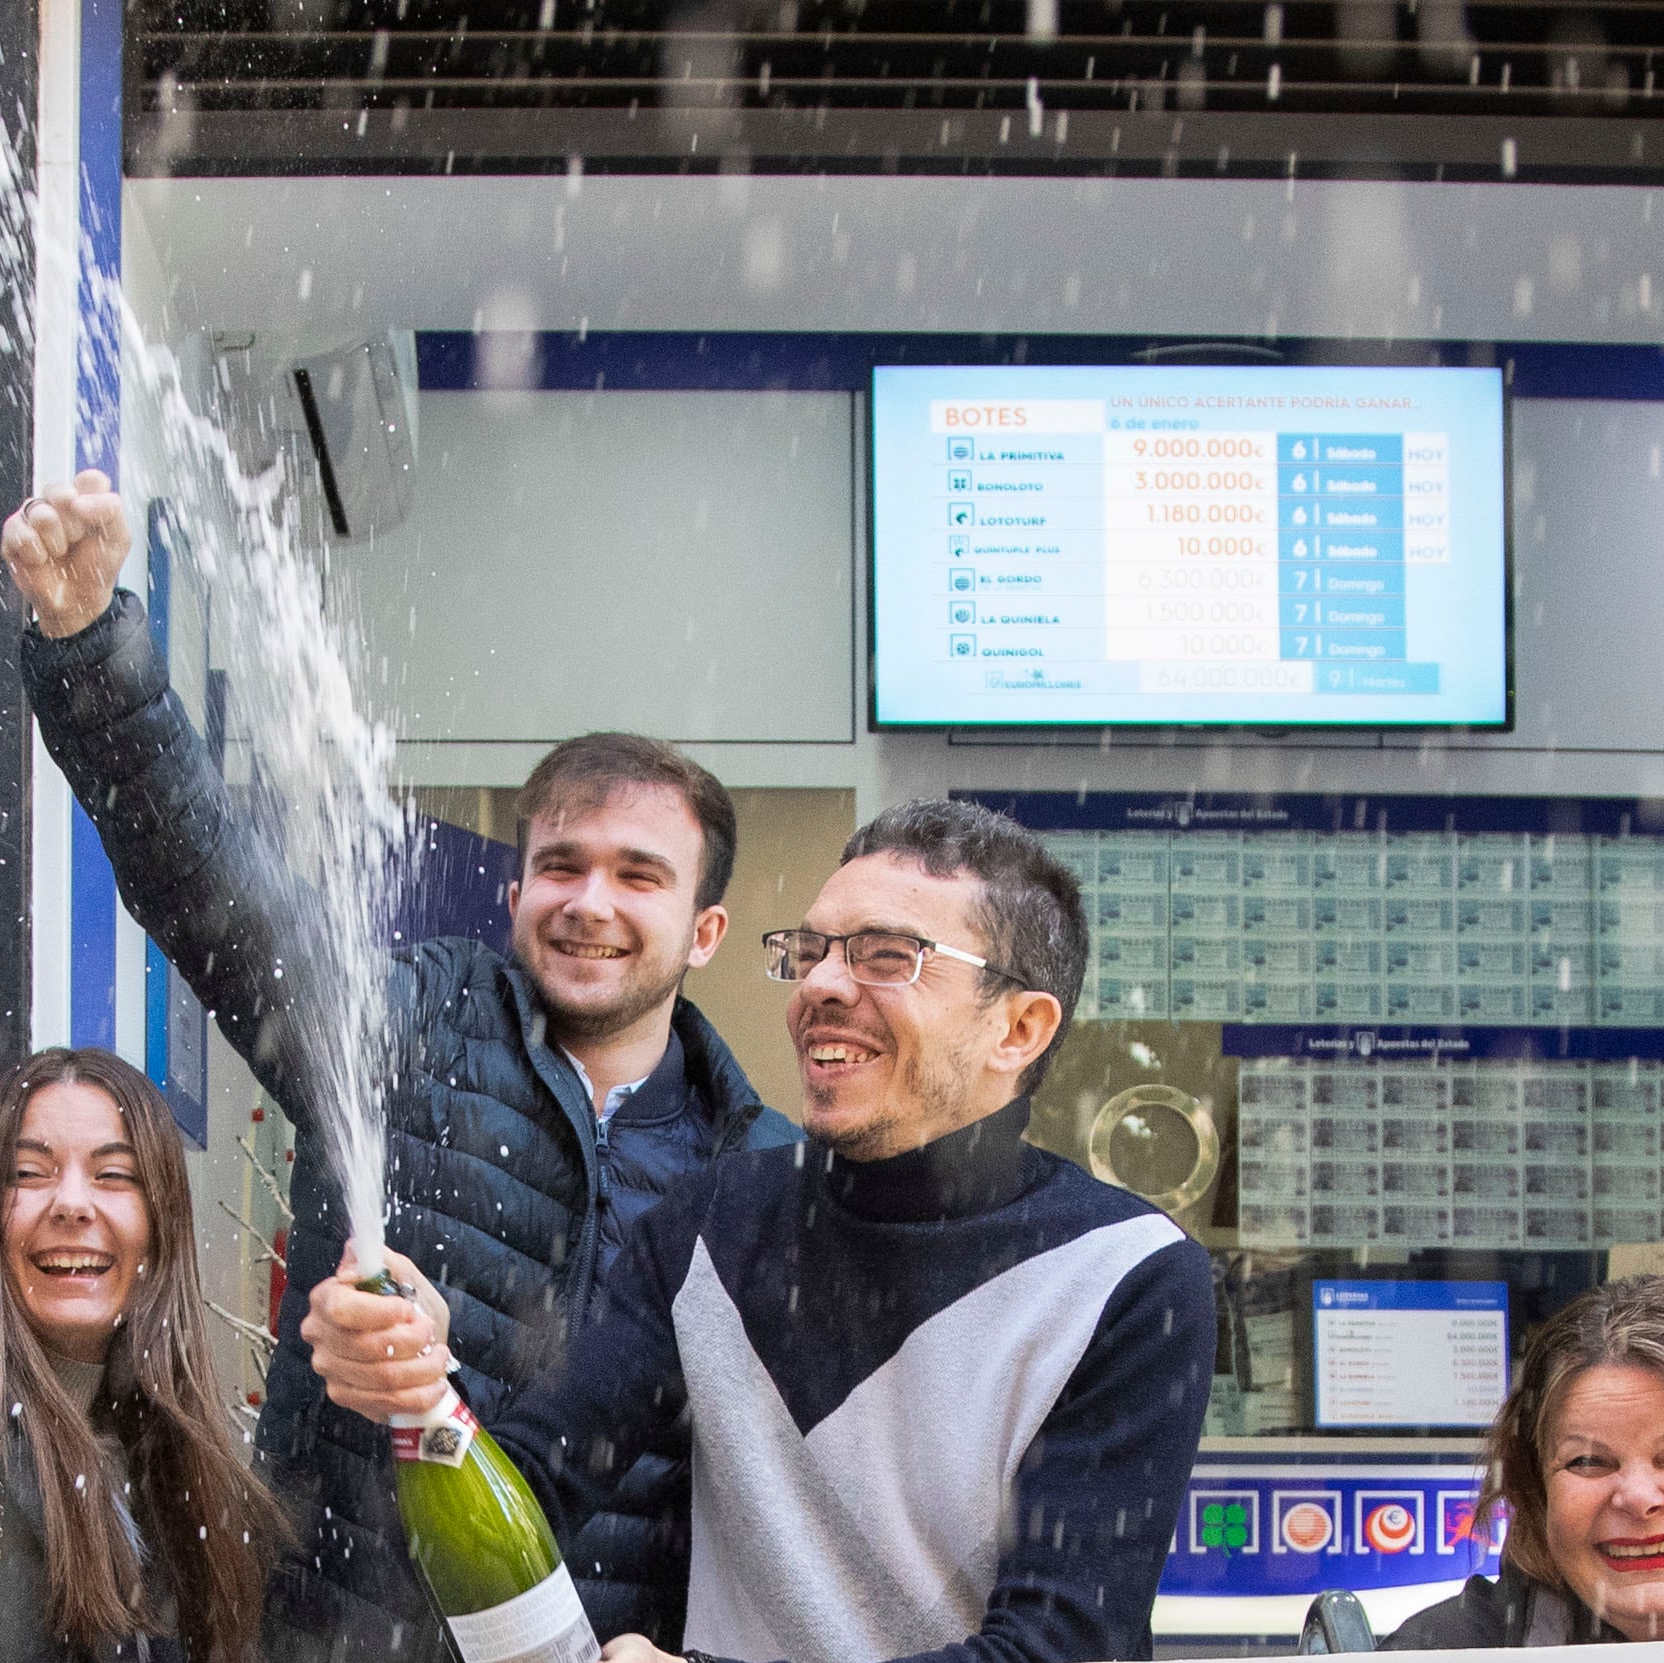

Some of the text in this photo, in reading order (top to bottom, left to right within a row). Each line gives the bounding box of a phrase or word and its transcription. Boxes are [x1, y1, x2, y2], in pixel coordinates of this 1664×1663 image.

[1110, 397, 1133, 409] UN
[1196, 397, 1286, 409] ACERTANTE
[944, 407, 1027, 427] BOTES
[1110, 418, 1200, 430] 6 de enero
[1133, 439, 1265, 459] 9.000.000€
[1292, 441, 1306, 460] 6
[1408, 449, 1443, 461] HOY
[979, 451, 1065, 461] LA PRIMITIVA
[977, 483, 1043, 492] BONOLOTO
[1134, 471, 1265, 491] 3.000.000€
[1292, 474, 1306, 492] 6
[1408, 481, 1443, 494] HOY
[1146, 504, 1265, 524] 1.180.000€
[1292, 506, 1307, 526] 6
[1409, 514, 1444, 526] HOY
[979, 517, 1047, 526] LOTOTURF
[1035, 546, 1060, 554] PLUS
[1178, 537, 1265, 557] 10.000€
[1293, 540, 1307, 558] 6
[1409, 547, 1444, 560] HOY
[979, 575, 1042, 584] EL GORDO
[1294, 572, 1384, 593] 7 Domingo
[981, 615, 1060, 625] LA QUINIELA
[1294, 605, 1385, 626] 7 Domingo
[981, 648, 1045, 657] QUINIGOL
[1295, 637, 1385, 658] 7 Domingo
[1377, 1039, 1419, 1050] Apuestas
